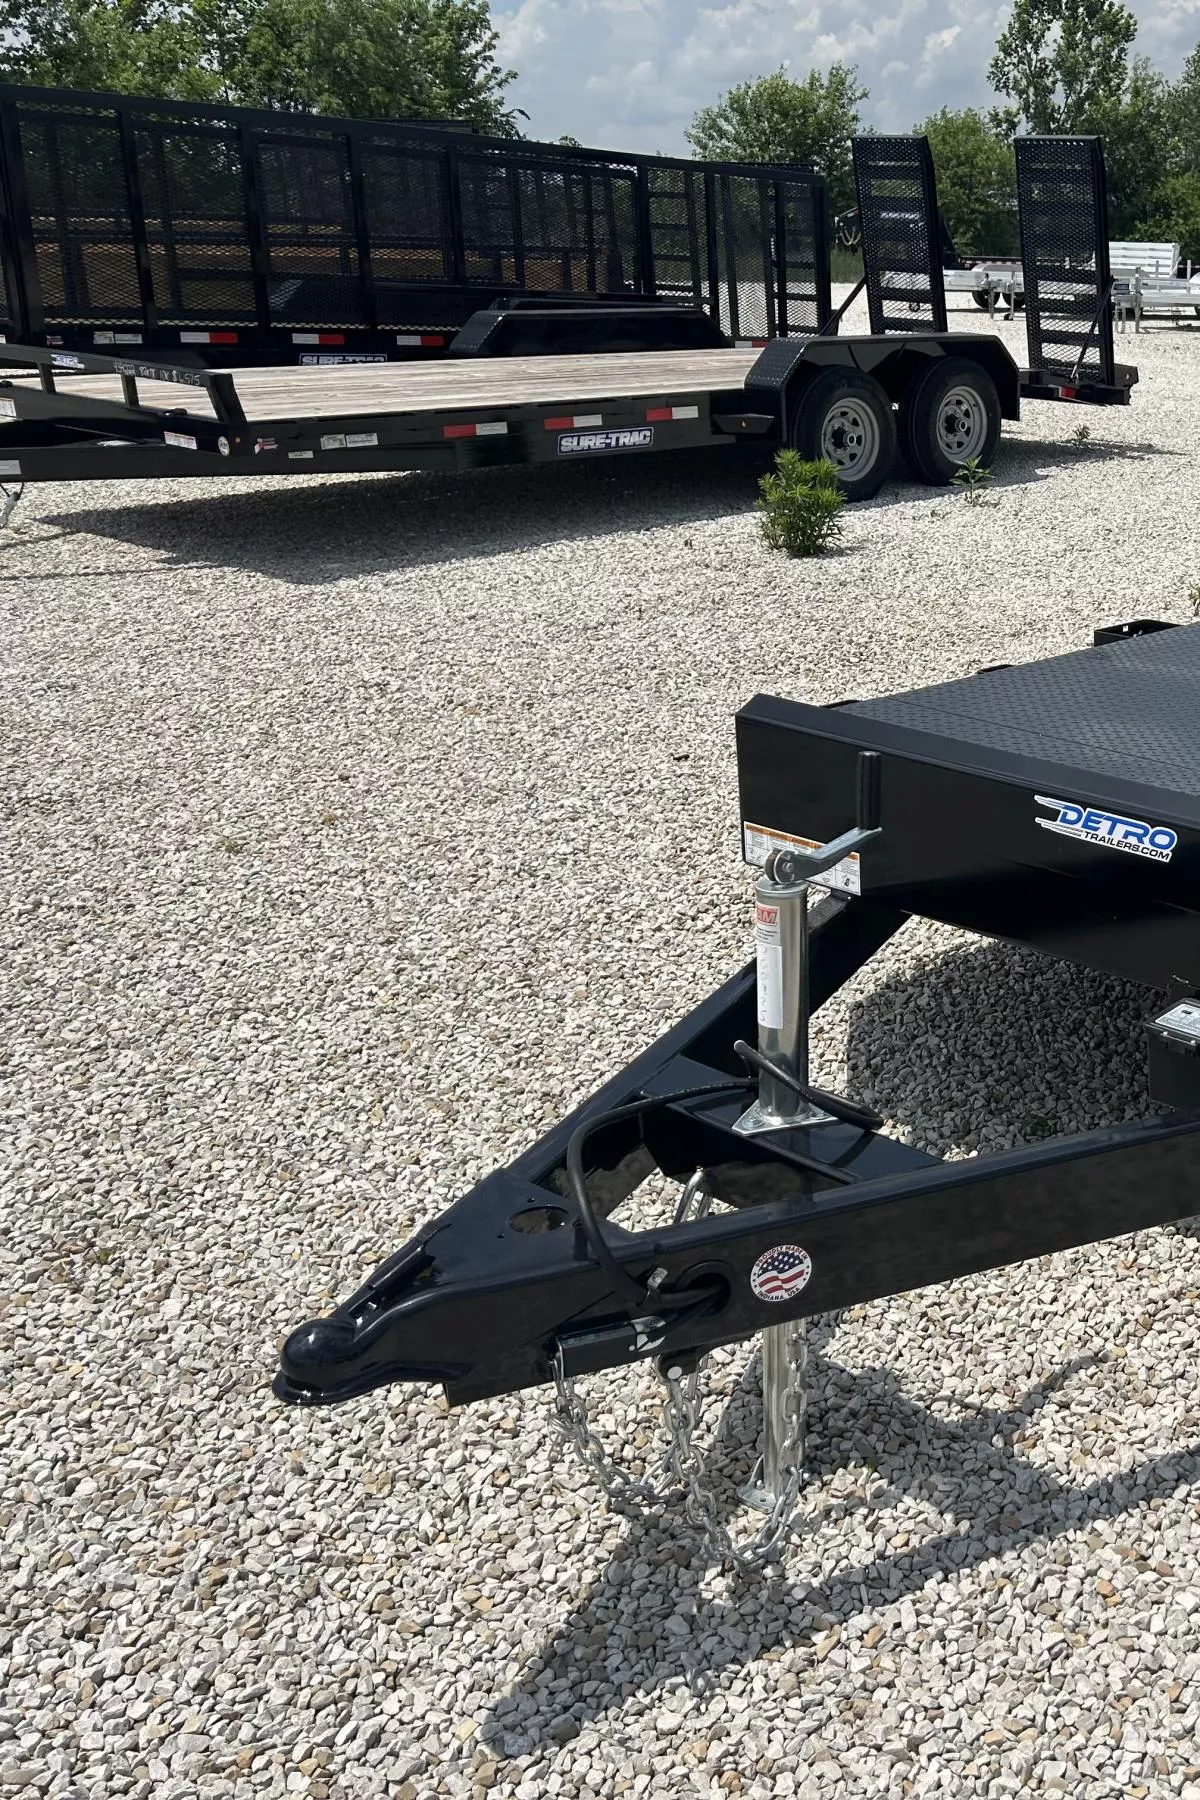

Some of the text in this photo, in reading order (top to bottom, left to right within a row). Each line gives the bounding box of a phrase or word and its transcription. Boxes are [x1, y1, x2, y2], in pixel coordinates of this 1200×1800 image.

[561, 430, 651, 452] SURE-TRAC
[1058, 804, 1176, 851] DETRO
[1084, 830, 1171, 861] TRAILERS.COM
[787, 1287, 801, 1297] USA
